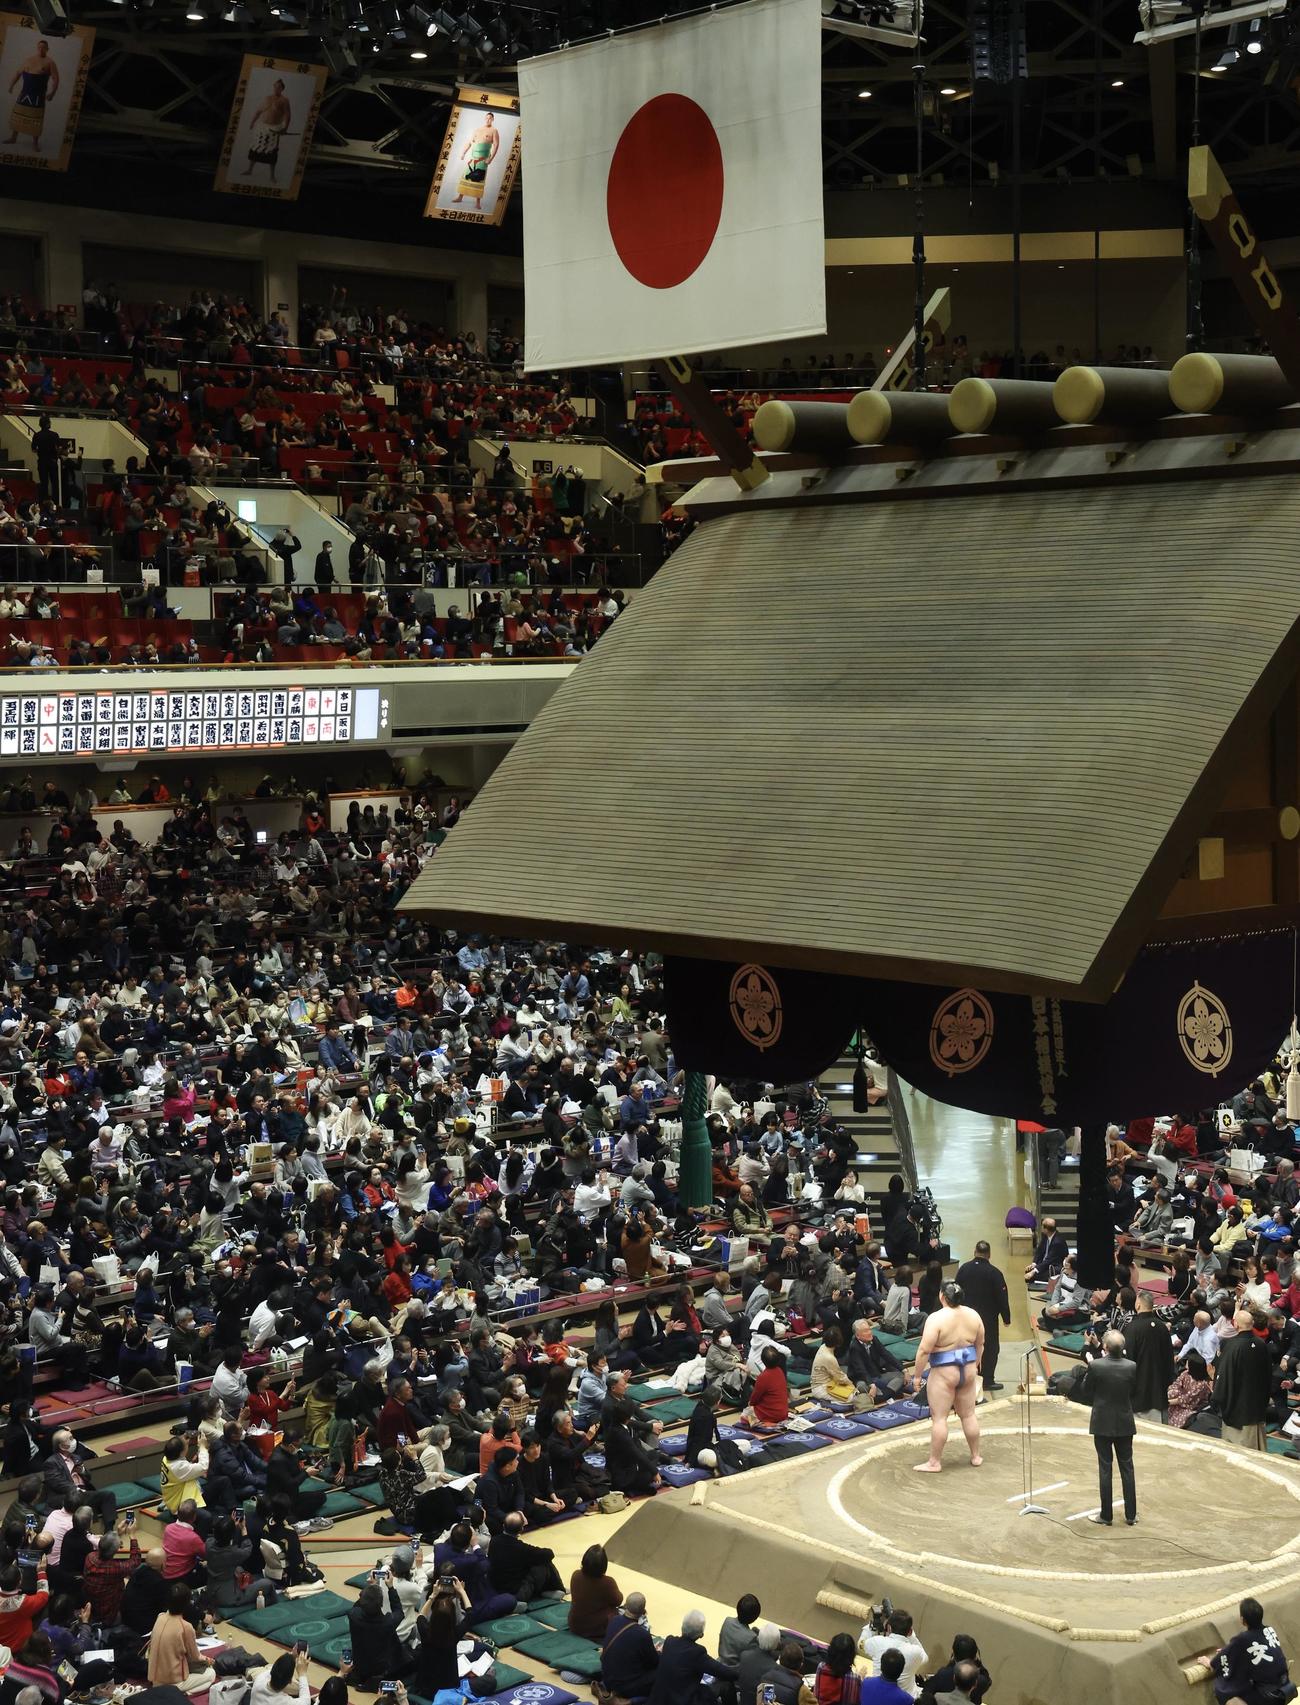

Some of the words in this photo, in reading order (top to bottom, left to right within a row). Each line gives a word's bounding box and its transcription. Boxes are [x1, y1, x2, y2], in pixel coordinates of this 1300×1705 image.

[440, 209, 485, 223] 毎日新聞社
[324, 697, 332, 708] 十
[341, 692, 348, 712] 本日
[44, 706, 54, 717] 中
[307, 724, 316, 736] 西
[43, 733, 53, 745] 入
